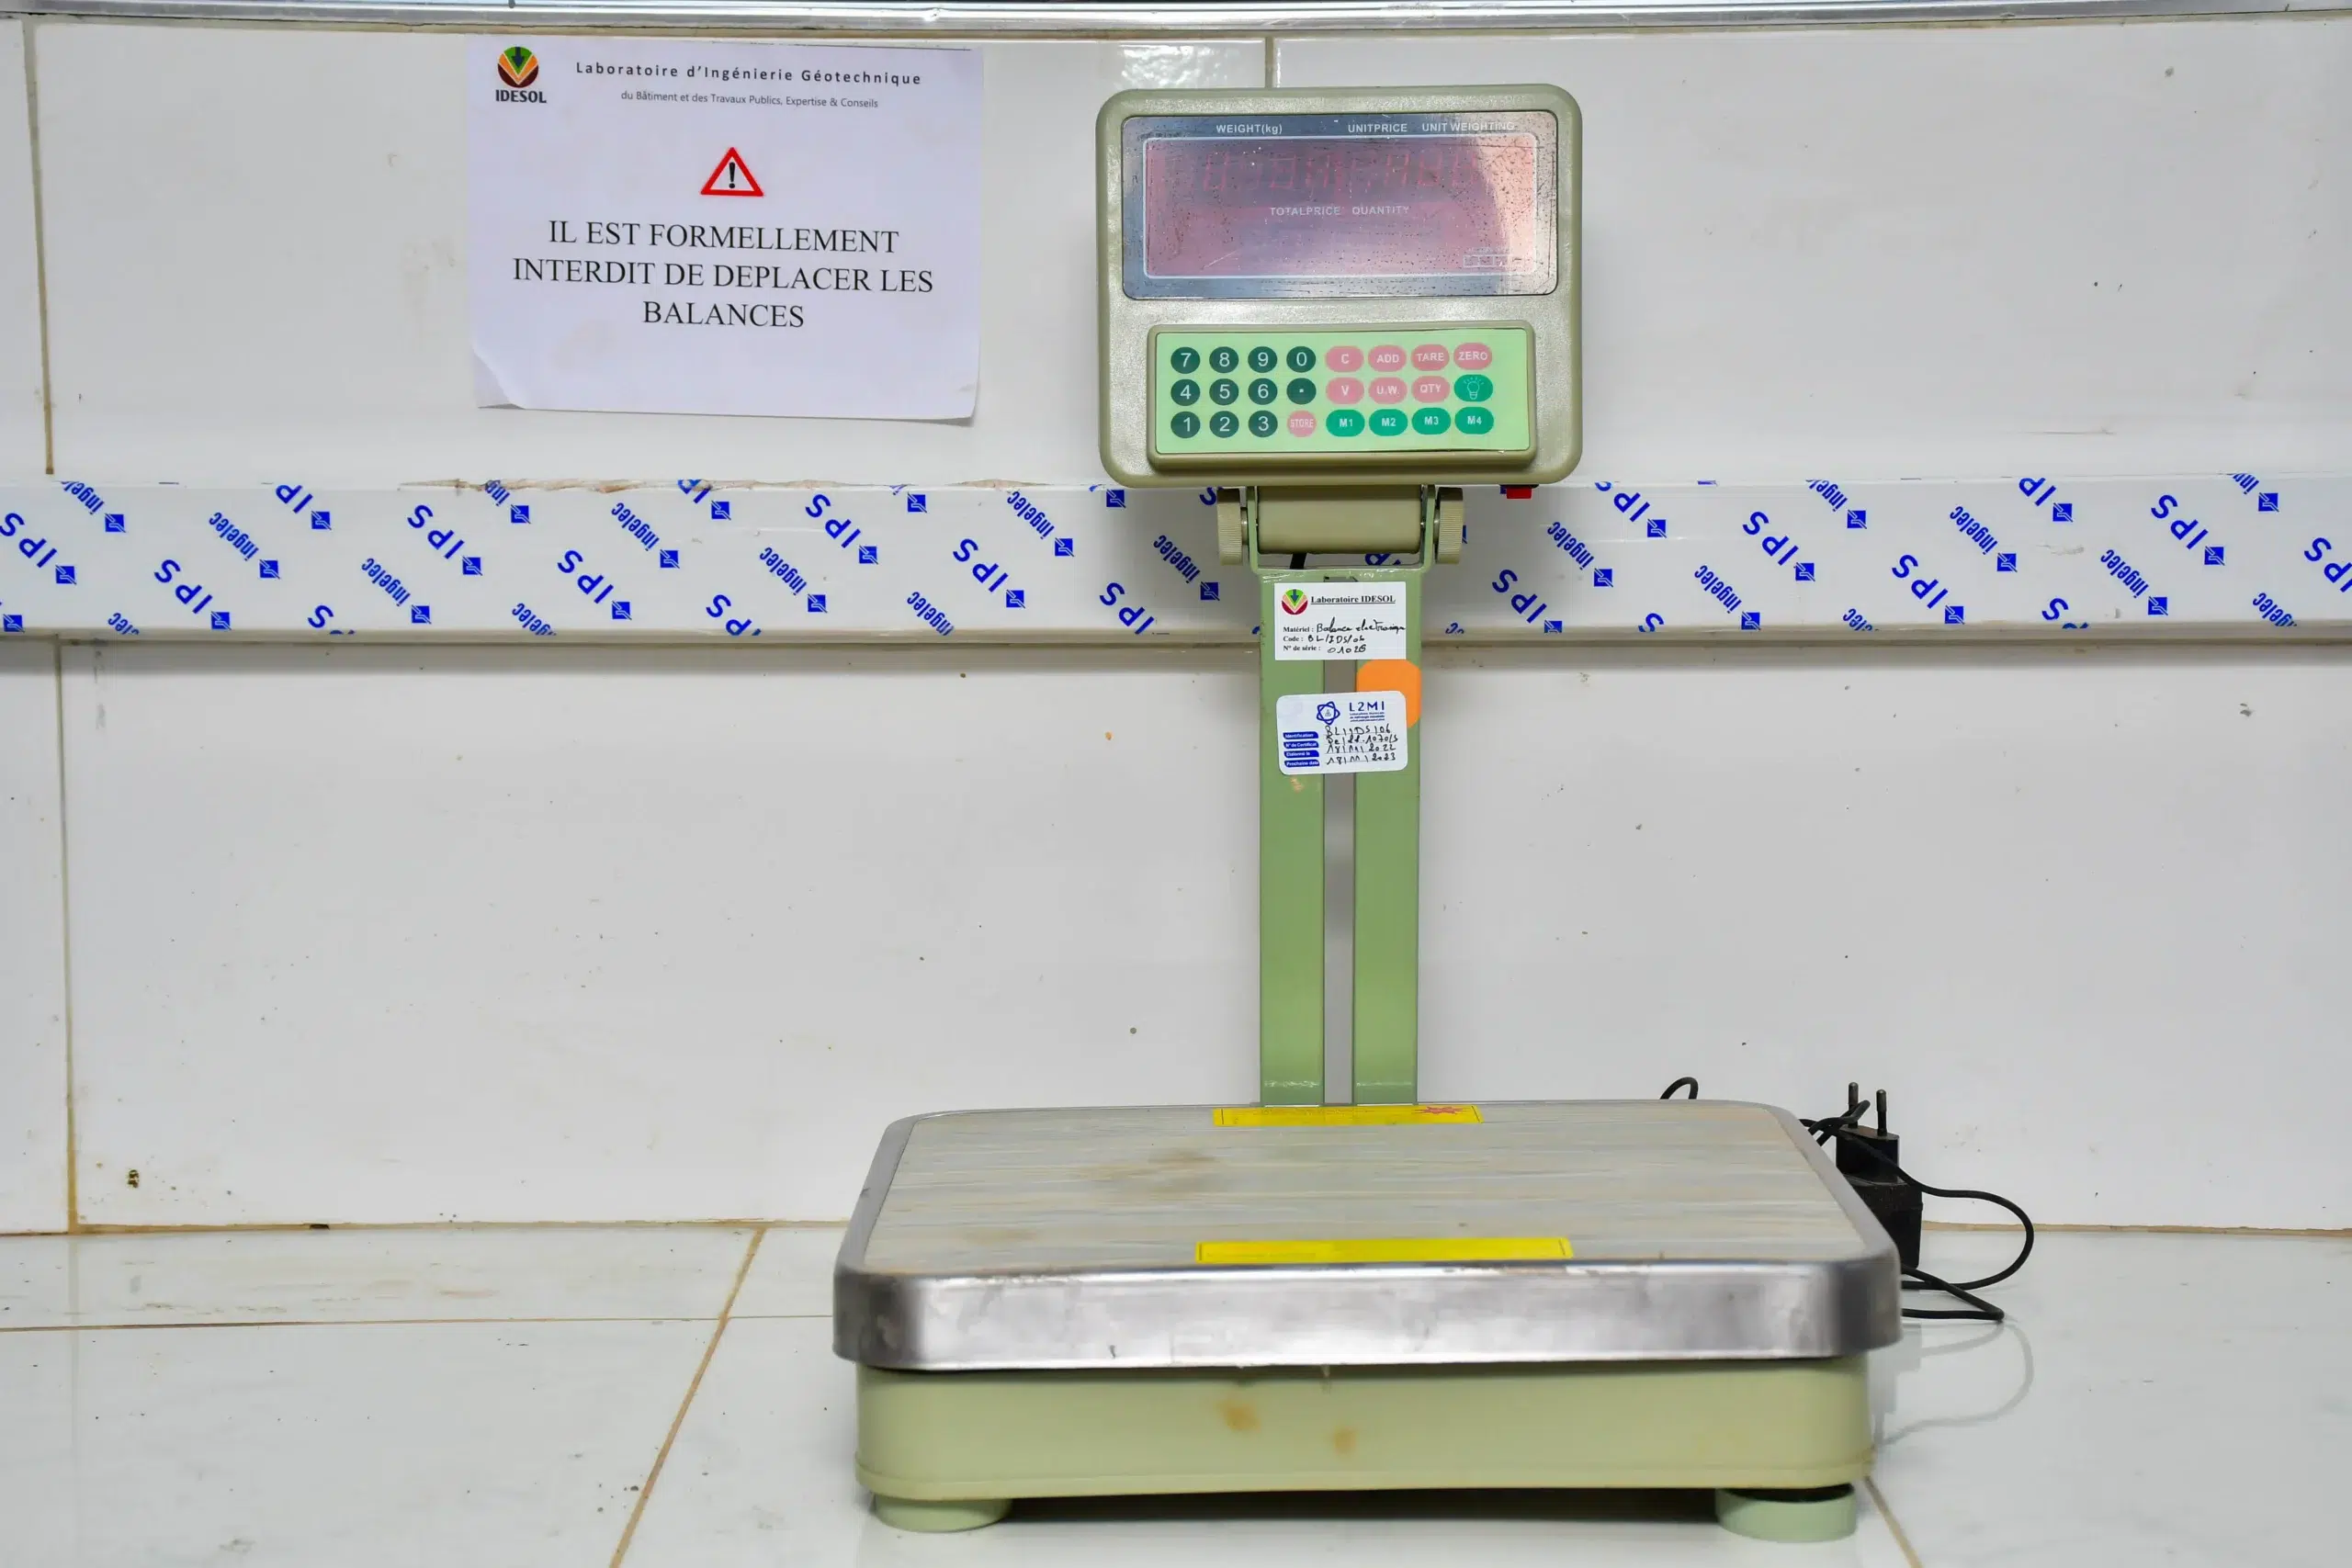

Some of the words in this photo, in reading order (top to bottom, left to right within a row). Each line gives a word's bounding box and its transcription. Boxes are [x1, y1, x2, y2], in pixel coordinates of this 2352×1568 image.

[577, 62, 677, 76] Laboratoire
[687, 66, 792, 81] d'Ingénierie
[802, 70, 920, 86] Géotechnique
[496, 90, 547, 103] IDESOL
[621, 91, 633, 99] du
[637, 91, 677, 101] Bâtiment
[692, 94, 707, 102] des
[711, 94, 746, 103] Travaux
[750, 96, 782, 105] Publics,
[786, 96, 827, 107] Expertise
[841, 98, 877, 107] Conseils
[1216, 123, 1283, 135] WEIGHT(kg)
[1348, 123, 1408, 133] UNITPRICE
[1421, 122, 1448, 132] UNIT
[1451, 121, 1515, 132] WEIGHTING
[1270, 207, 1340, 217] TOTALPRICE
[1351, 205, 1409, 216] QUANTITY
[551, 221, 576, 243] IL
[588, 222, 639, 244] EST
[650, 224, 899, 253] FORMELLEMENT
[515, 258, 655, 284] INTERDIT
[666, 264, 703, 286] DE
[715, 265, 871, 290] DEPLACER
[882, 270, 933, 292] LES
[644, 301, 803, 327] BALANCES
[1182, 353, 1191, 367] 7
[1219, 353, 1229, 367] 8
[1258, 353, 1268, 367] 9
[1296, 352, 1306, 366] 0
[1341, 354, 1349, 364] C
[1377, 355, 1399, 363] ADD
[1417, 353, 1444, 361] TARE
[1458, 351, 1487, 361] ZERO
[1181, 385, 1191, 399] 4
[1220, 384, 1229, 399] 5
[1258, 384, 1268, 398] 6
[1341, 386, 1349, 396] V
[1377, 386, 1399, 394] U.W.
[1420, 384, 1441, 393] QTY
[1183, 417, 1190, 432] 1
[1220, 417, 1229, 431] 2
[1259, 416, 1269, 431] 3
[1291, 419, 1313, 428] STORE
[1340, 419, 1352, 427] M1
[1382, 418, 1396, 426] M2
[1425, 416, 1438, 424] M3
[1467, 416, 1481, 424] M4
[806, 494, 860, 548] IPS
[1007, 492, 1055, 539] ingelec
[2152, 495, 2208, 549] IPS
[407, 505, 465, 559] IPS
[612, 502, 660, 549] ingelec
[1951, 506, 1998, 556] ingelec
[0, 513, 58, 569] IPS
[209, 513, 259, 559] ingelec
[1743, 512, 1799, 565] IPS
[1548, 522, 1595, 570] ingelec
[954, 538, 1009, 592] IPS
[1154, 535, 1202, 583] ingelec
[558, 549, 614, 604] IPS
[760, 547, 808, 596] ingelec
[2101, 549, 2150, 599] ingelec
[155, 559, 213, 615] IPS
[361, 558, 411, 605] ingelec
[1893, 555, 1949, 609] IPS
[1493, 570, 1547, 624] IPS
[1694, 565, 1742, 614] ingelec
[1100, 582, 1155, 635] IPS
[1349, 701, 1385, 712] L2MI
